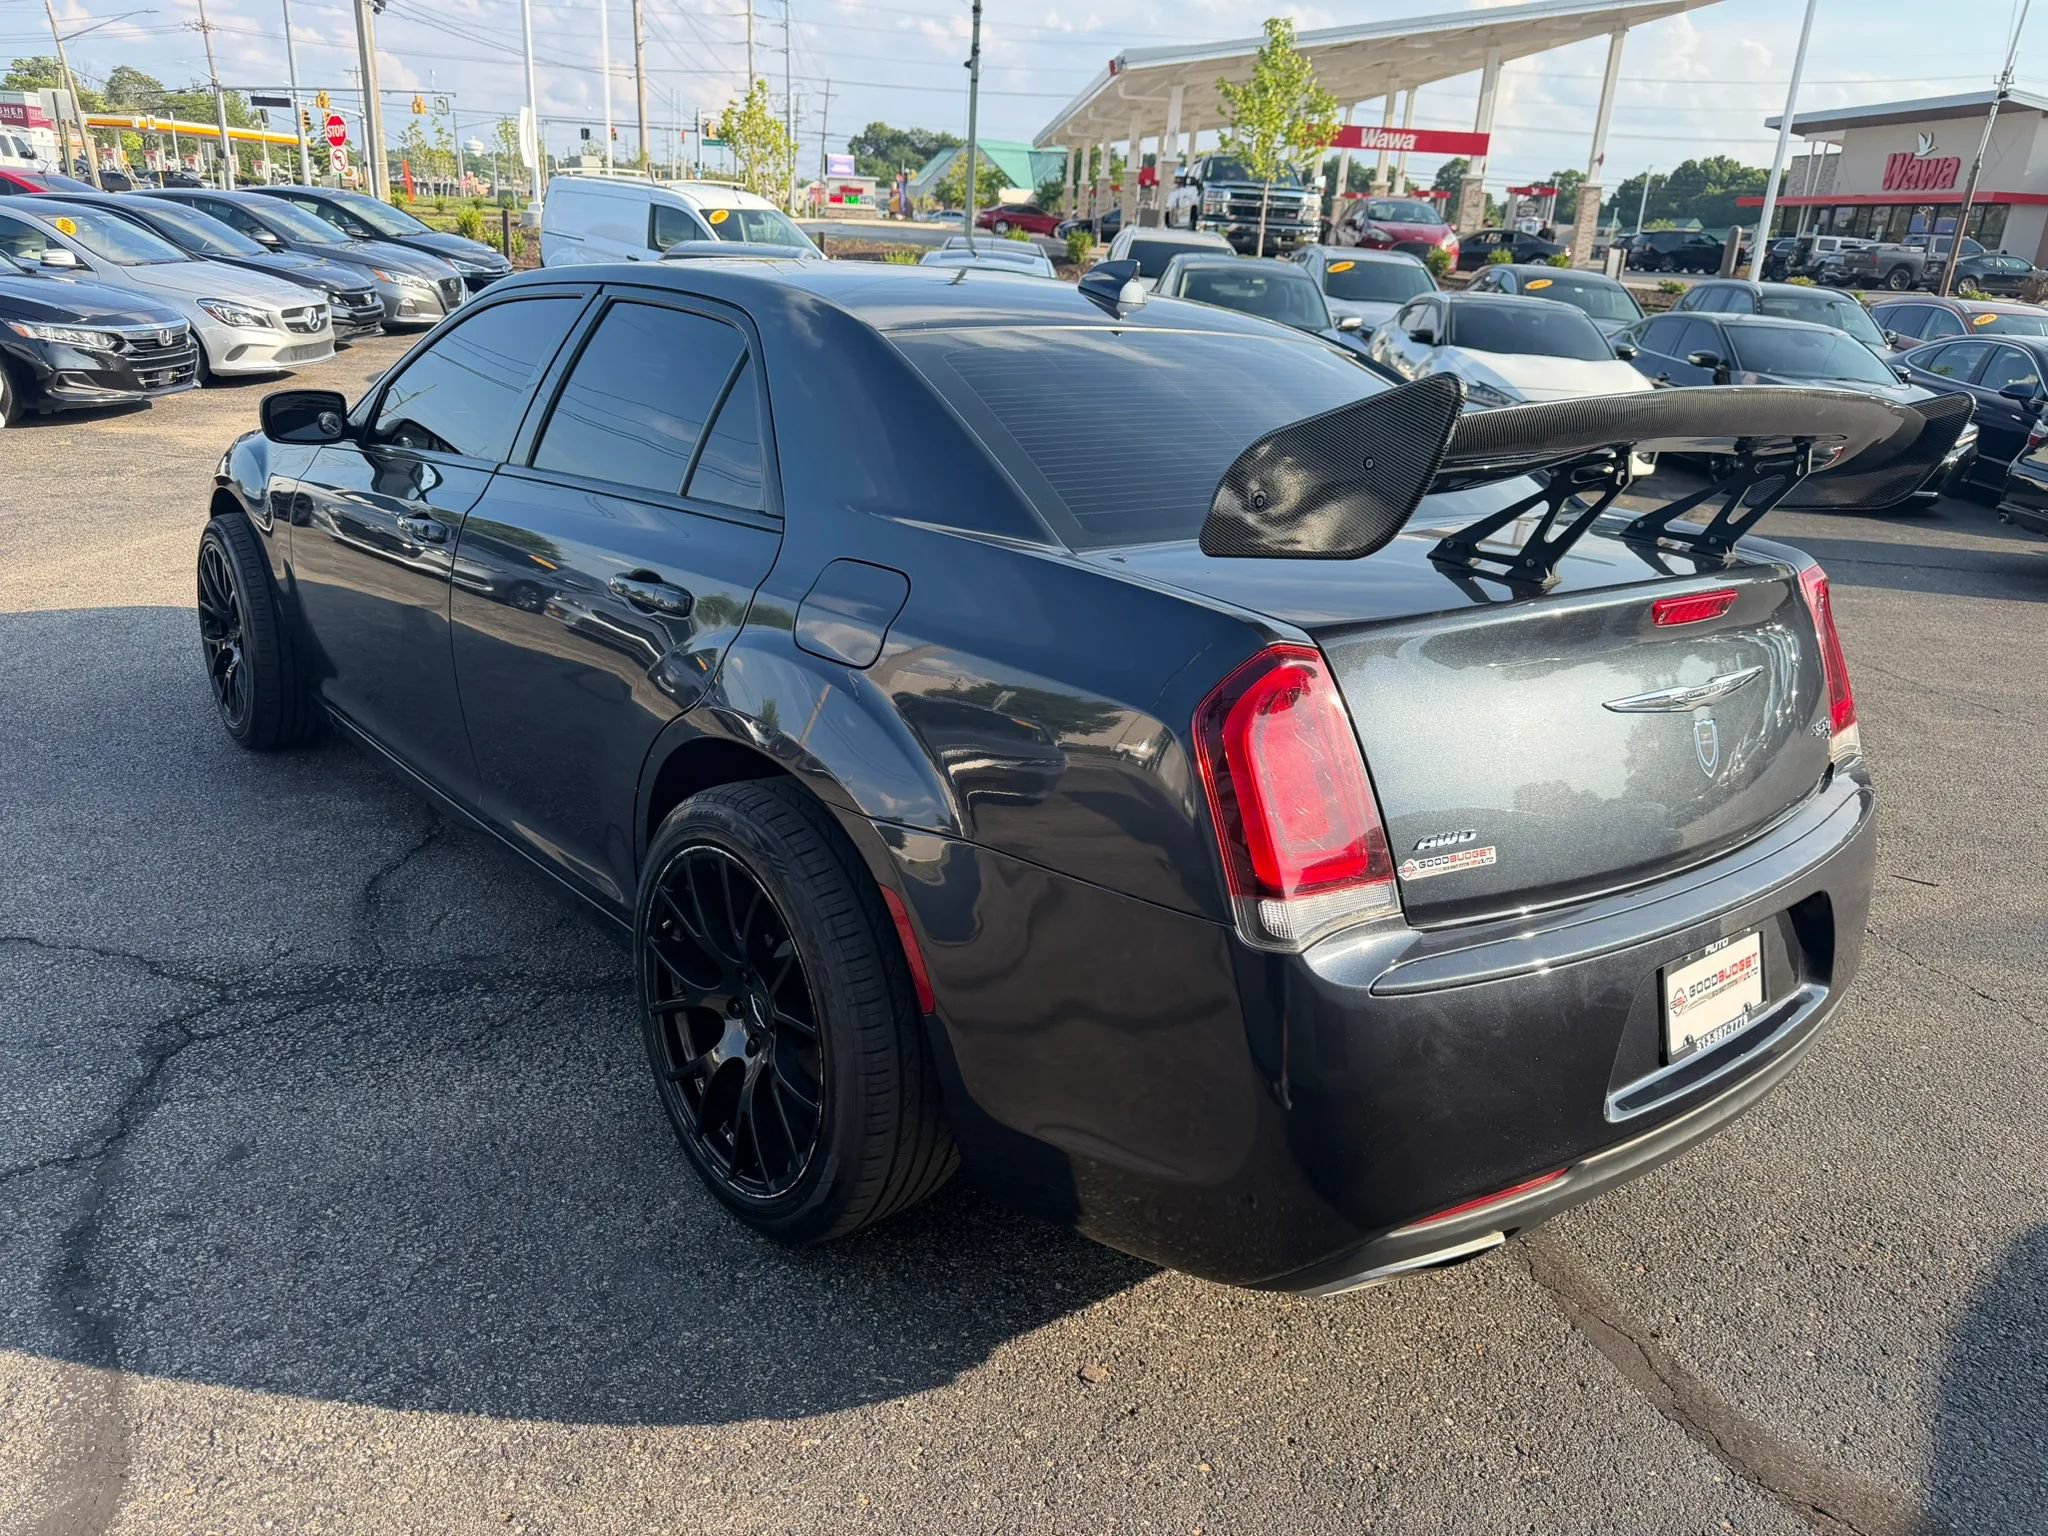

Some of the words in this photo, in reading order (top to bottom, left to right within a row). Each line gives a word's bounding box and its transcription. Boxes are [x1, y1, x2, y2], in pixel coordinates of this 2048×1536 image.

[326, 124, 345, 138] STOP
[1360, 128, 1416, 150] Wawa
[1883, 152, 1961, 191] Wawa
[1412, 829, 1477, 851] AWD
[1705, 938, 1728, 955] AUTO
[1689, 952, 1758, 998] GOODBUDGET
